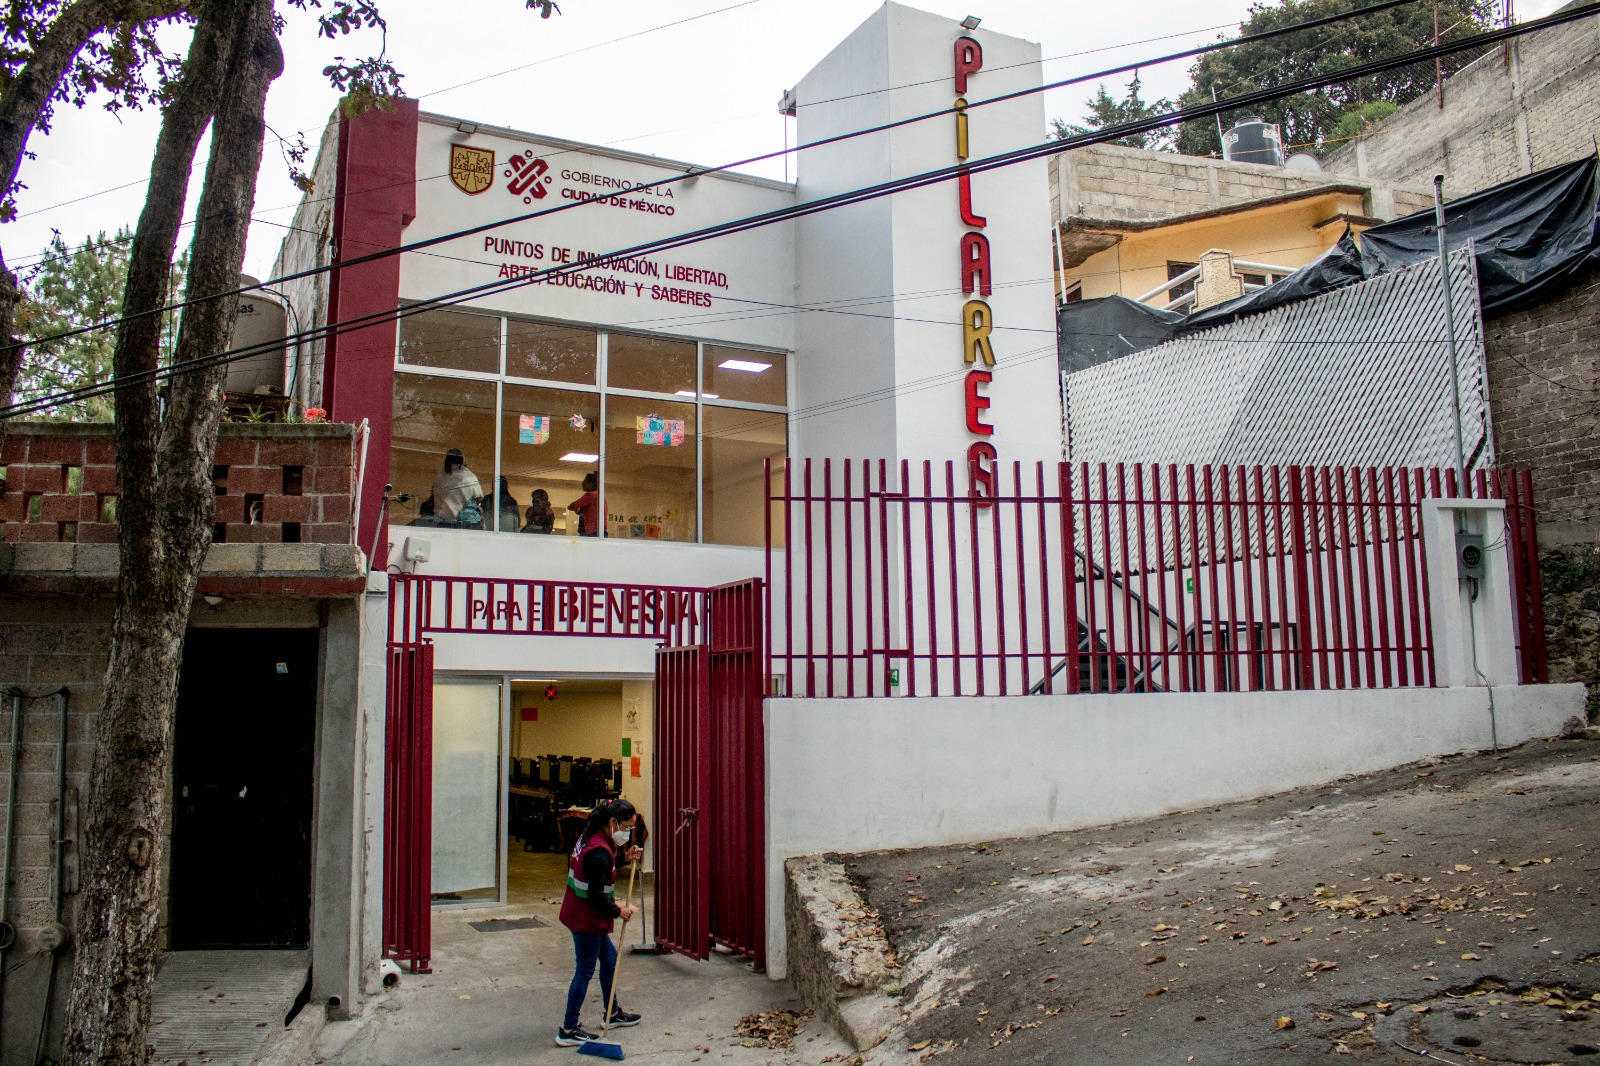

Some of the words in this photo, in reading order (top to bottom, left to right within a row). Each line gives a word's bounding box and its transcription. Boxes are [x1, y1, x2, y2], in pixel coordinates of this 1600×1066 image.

[561, 169, 632, 190] GOBIERNO
[636, 182, 653, 195] DE
[656, 186, 674, 198] LA
[561, 188, 608, 205] CIUDAD
[610, 197, 627, 208] DE
[629, 198, 675, 216] MÉXICO
[484, 236, 544, 260] PUNTOS
[551, 246, 571, 264] DE
[577, 250, 660, 280] INNOVACIÓN,
[665, 263, 729, 291] LIBERTAD,
[498, 263, 541, 286] ARTE,
[546, 271, 626, 296] EDUCACIÓN
[634, 281, 644, 298] Y
[651, 284, 712, 308] SABERES
[240, 304, 254, 313] as
[608, 513, 624, 523] RIA
[473, 599, 523, 621] PARA
[559, 588, 710, 626] BIENESA
